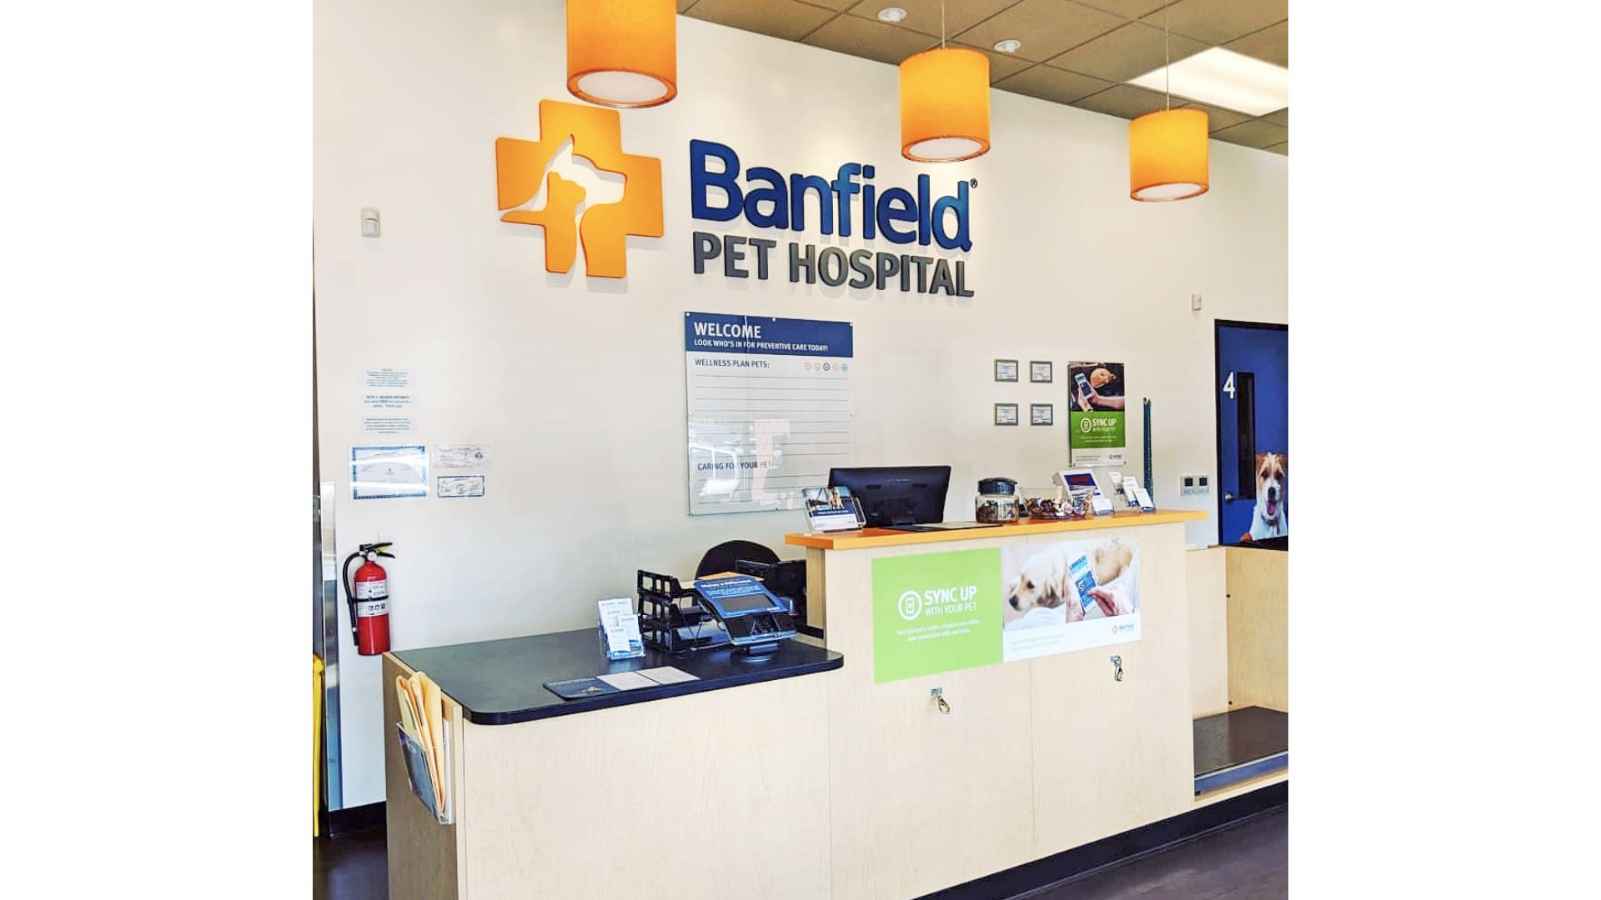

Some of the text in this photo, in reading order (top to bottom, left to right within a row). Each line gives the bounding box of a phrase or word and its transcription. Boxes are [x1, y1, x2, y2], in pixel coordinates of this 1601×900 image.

[689, 139, 973, 252] Banfield
[692, 231, 974, 298] PET HOSPITAL
[694, 321, 762, 339] WELCOME
[694, 339, 713, 347] LOOK
[713, 340, 735, 348] WHO'S
[743, 341, 756, 349] FOR
[756, 342, 792, 350] PREVENTIVE
[792, 343, 808, 351] CARE
[695, 359, 770, 369] WELLNESS PLAN PETS:
[1223, 371, 1236, 399] 4
[697, 462, 724, 471] CARING
[740, 461, 758, 470] YOUR
[924, 585, 977, 605] SYNC UP
[925, 606, 945, 617] WITH
